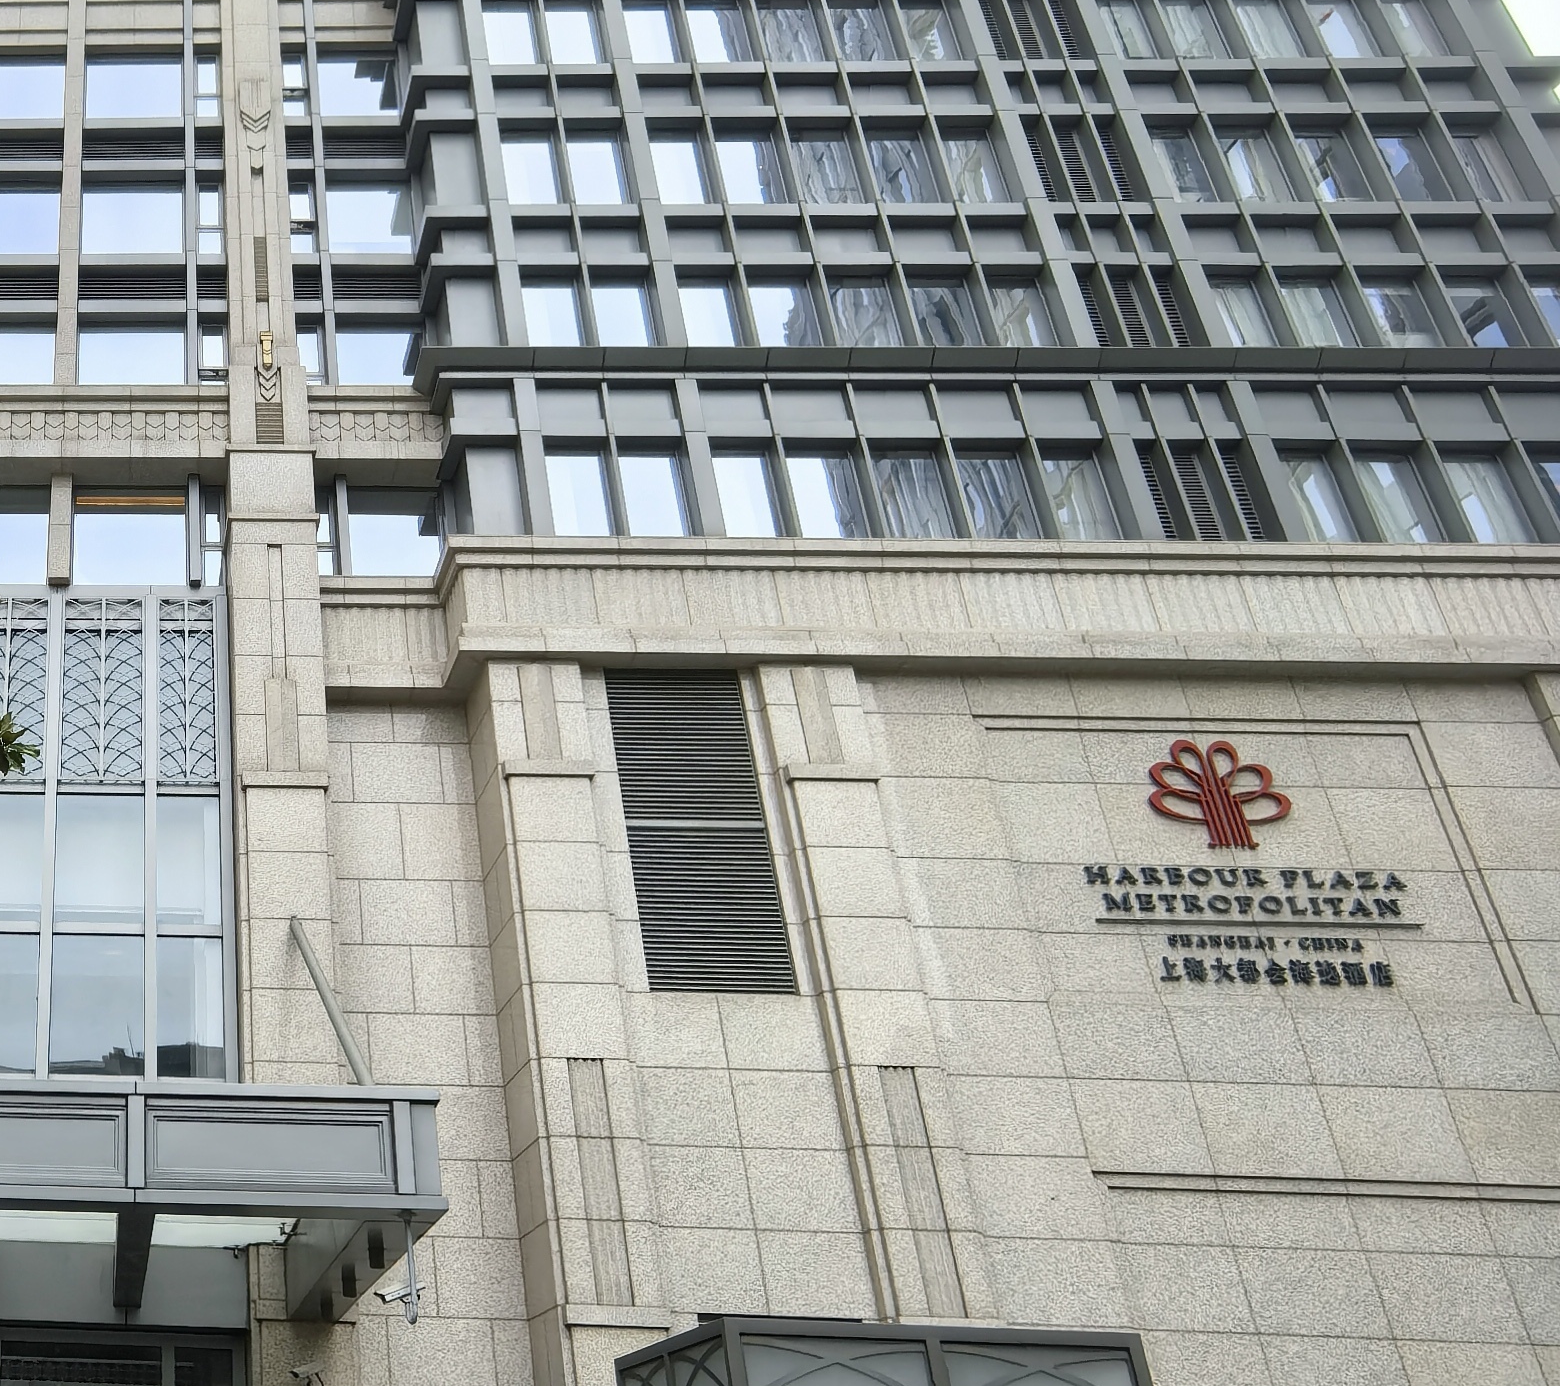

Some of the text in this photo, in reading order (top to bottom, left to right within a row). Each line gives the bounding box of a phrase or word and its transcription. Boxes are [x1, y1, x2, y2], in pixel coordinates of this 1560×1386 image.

[1083, 866, 1408, 891] HARBOUR PLAZA
[1101, 893, 1402, 917] METROPOLITAN
